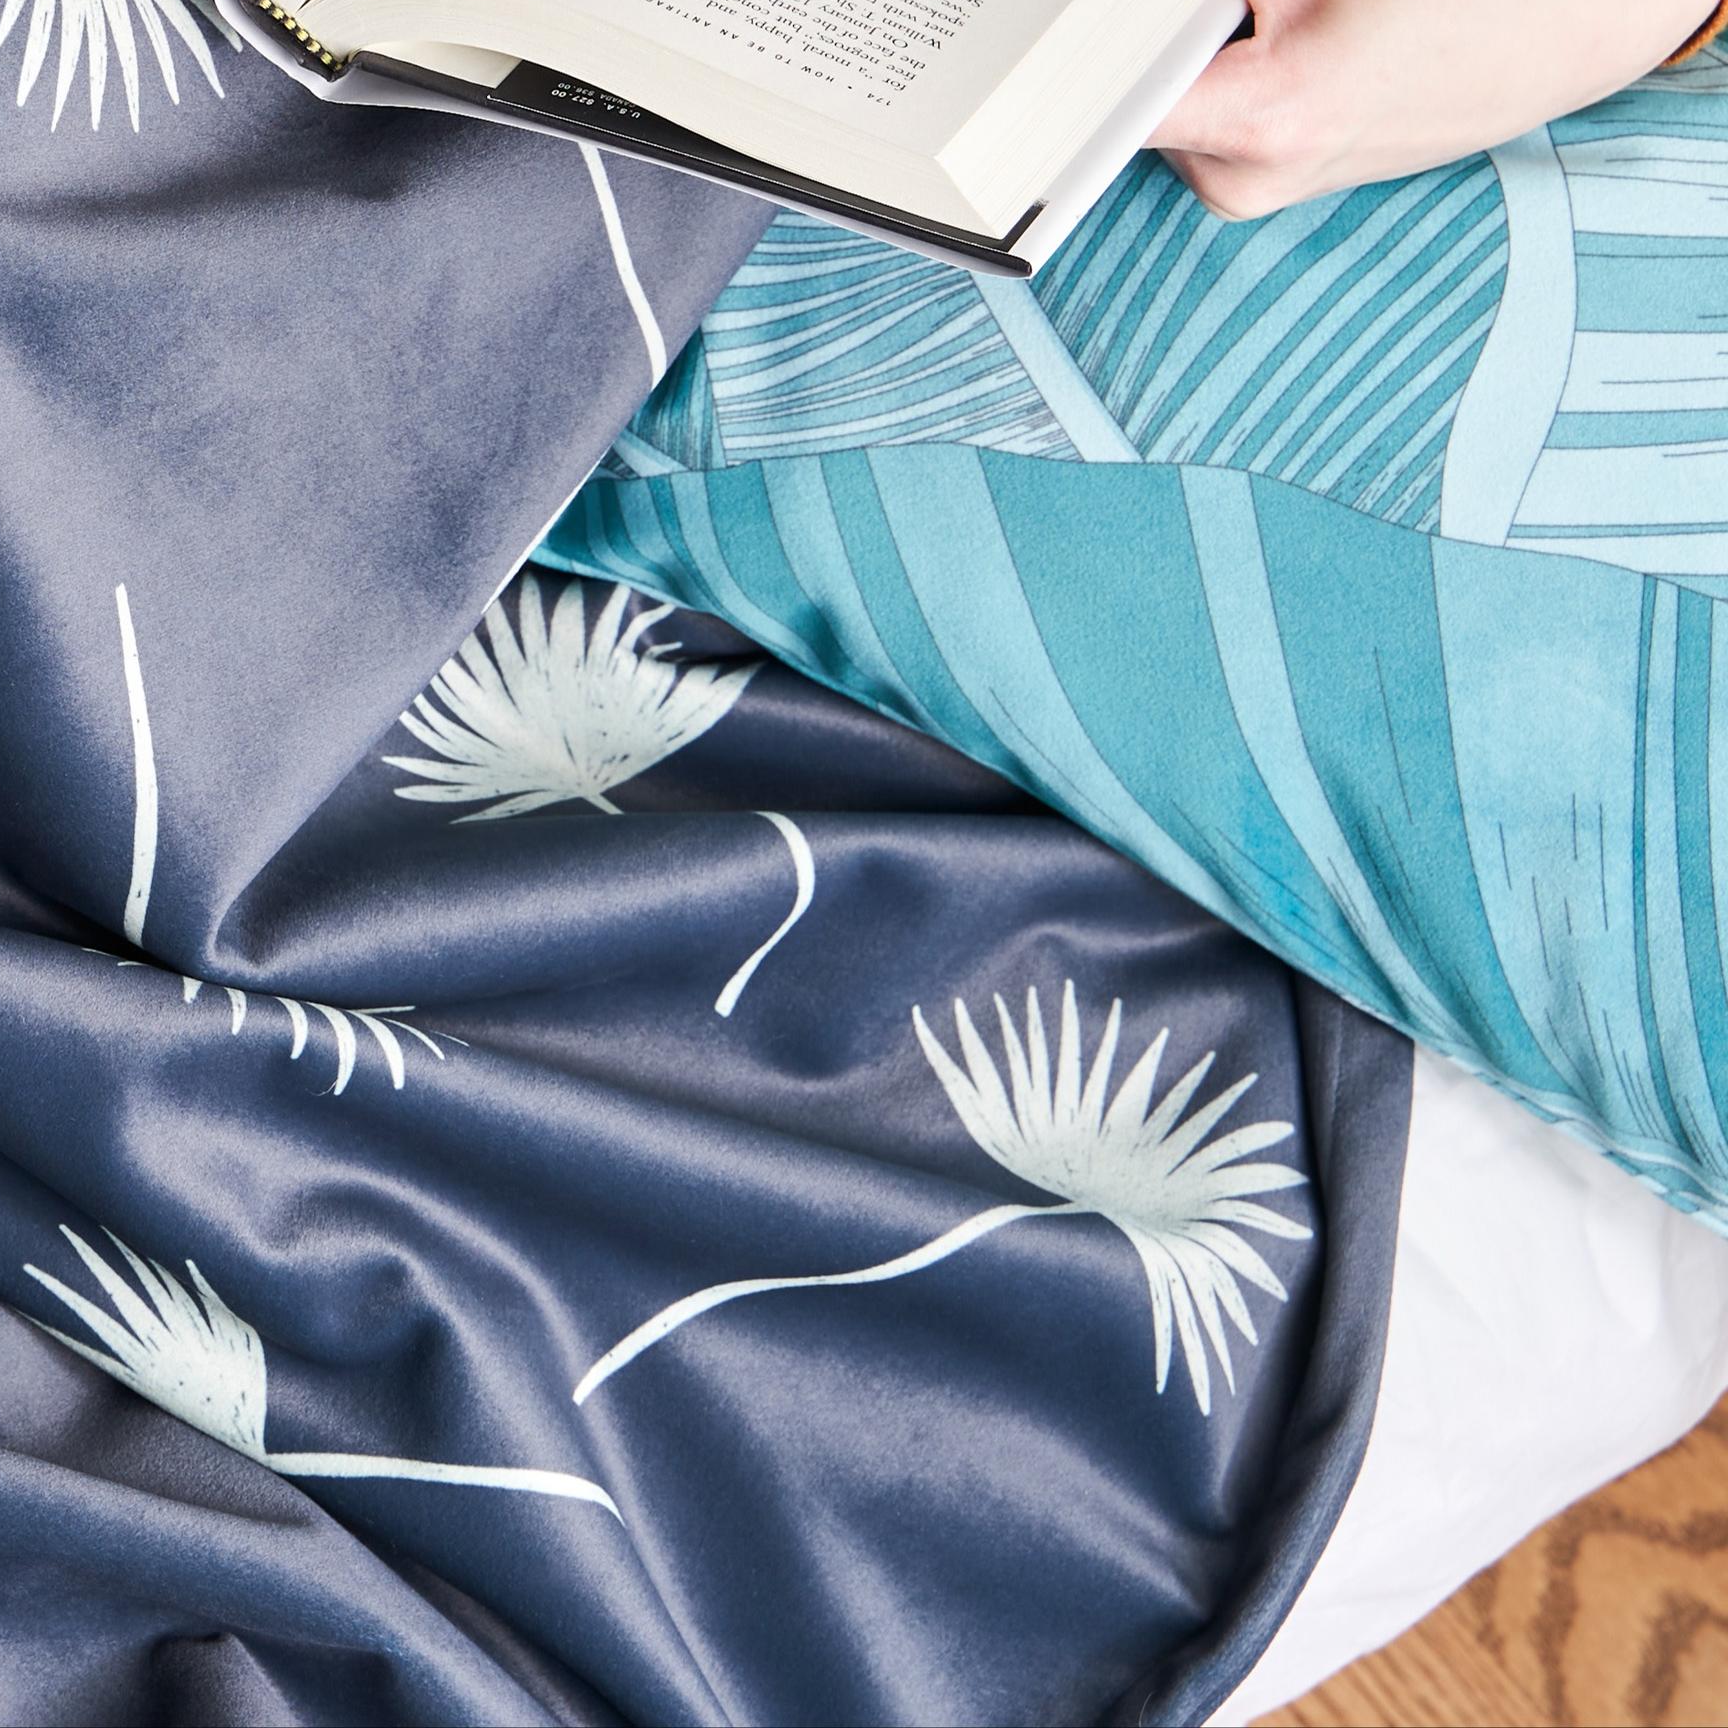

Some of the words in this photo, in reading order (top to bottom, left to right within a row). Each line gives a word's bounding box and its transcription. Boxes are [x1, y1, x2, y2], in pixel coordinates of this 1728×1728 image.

[816, 3, 879, 36] January
[881, 1, 917, 23] with
[744, 13, 793, 44] happy,
[774, 15, 803, 33] but
[811, 16, 838, 32] the
[881, 16, 941, 50] William
[922, 20, 955, 38] met
[718, 27, 739, 40] AN
[840, 29, 859, 41] of
[881, 31, 909, 49] On
[745, 39, 766, 53] BE
[801, 39, 852, 67] moral,
[803, 30, 880, 65] negroes,”
[862, 38, 896, 58] face
[773, 52, 792, 65] TO
[898, 54, 926, 70] the
[799, 64, 835, 83] HOW
[857, 65, 873, 80] “a
[884, 63, 917, 82] free
[881, 77, 907, 91] for
[552, 90, 594, 105] $27.00
[865, 91, 891, 107] 174
[604, 103, 640, 118] U.S.A.
